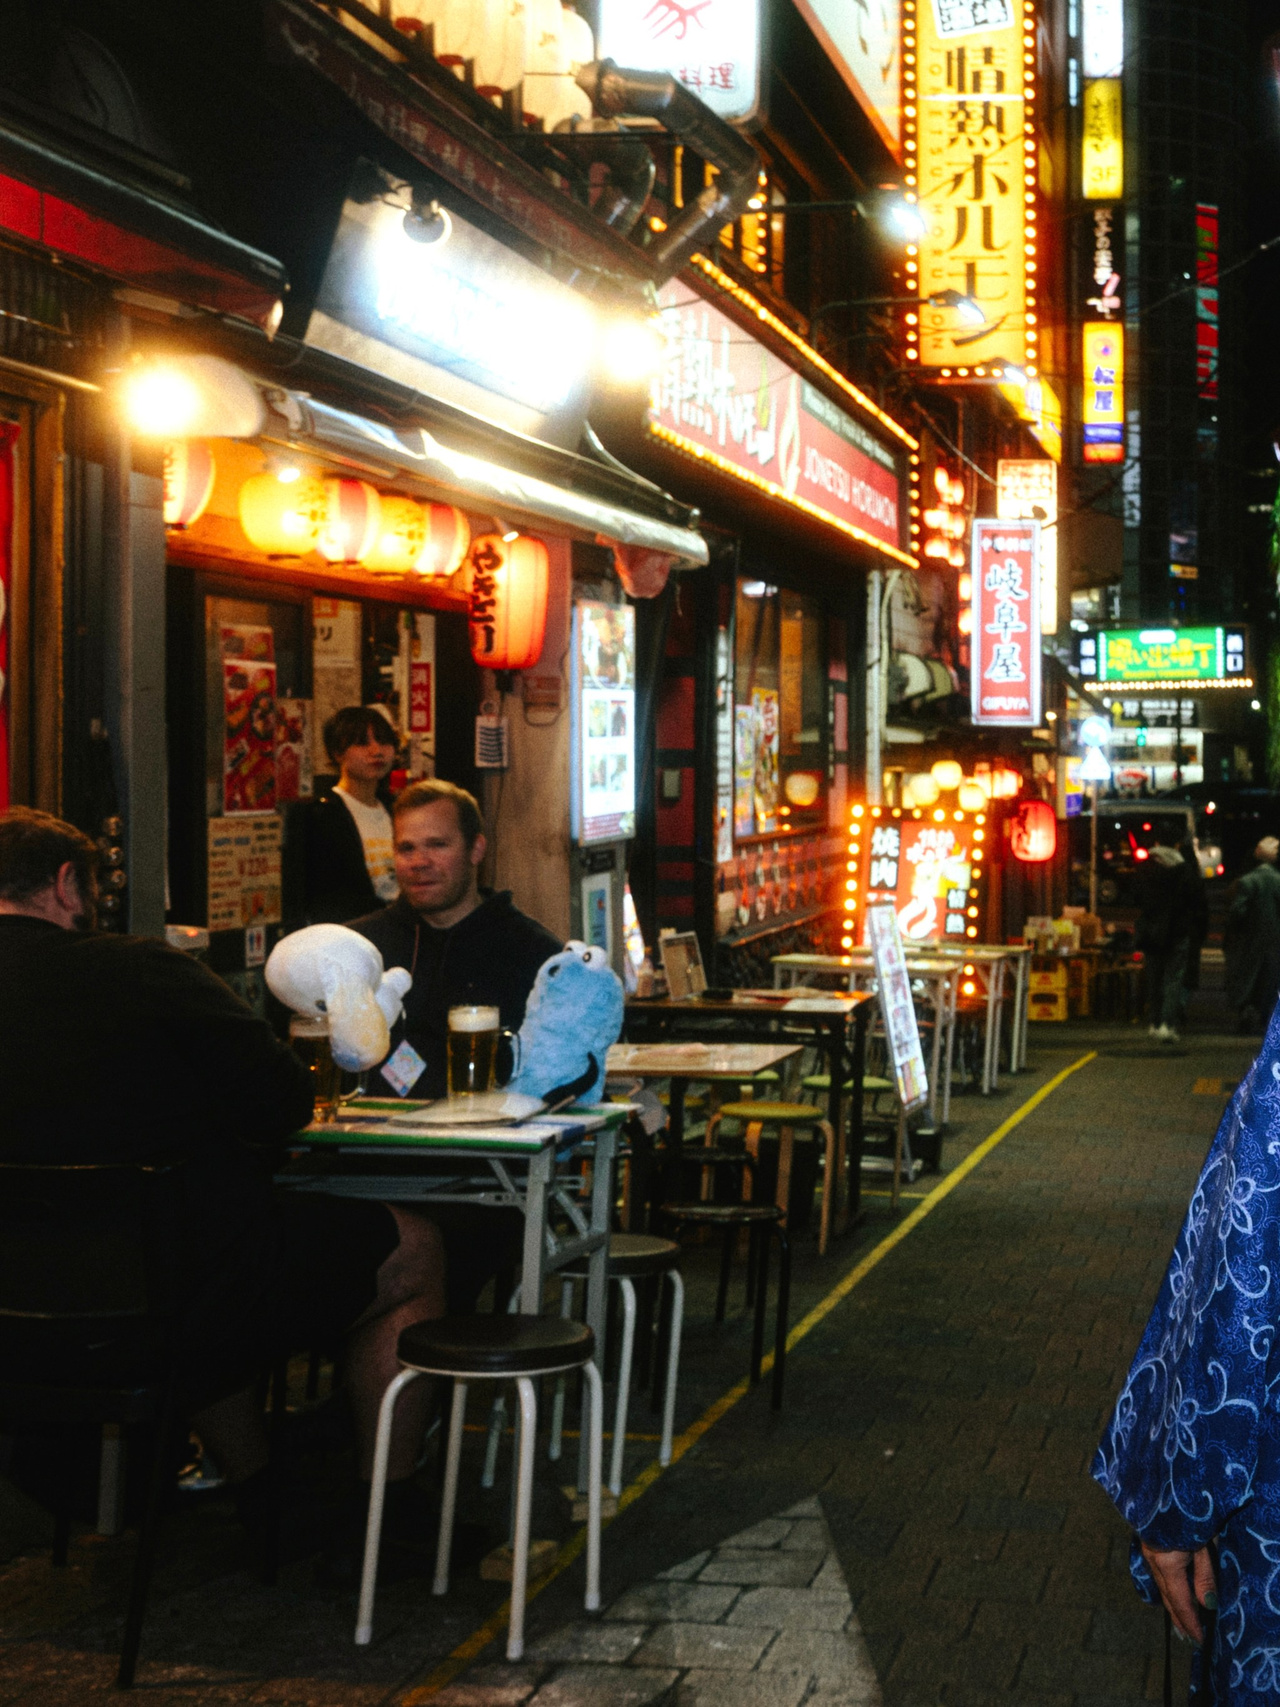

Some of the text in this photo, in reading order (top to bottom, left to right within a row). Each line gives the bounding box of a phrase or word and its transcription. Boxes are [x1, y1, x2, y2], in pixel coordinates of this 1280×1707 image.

[947, 46, 1012, 347] 情熱ホルモン
[931, 203, 943, 349] HORUON
[985, 559, 1029, 684] 岐阜屋
[983, 696, 1029, 711] GIFUYA
